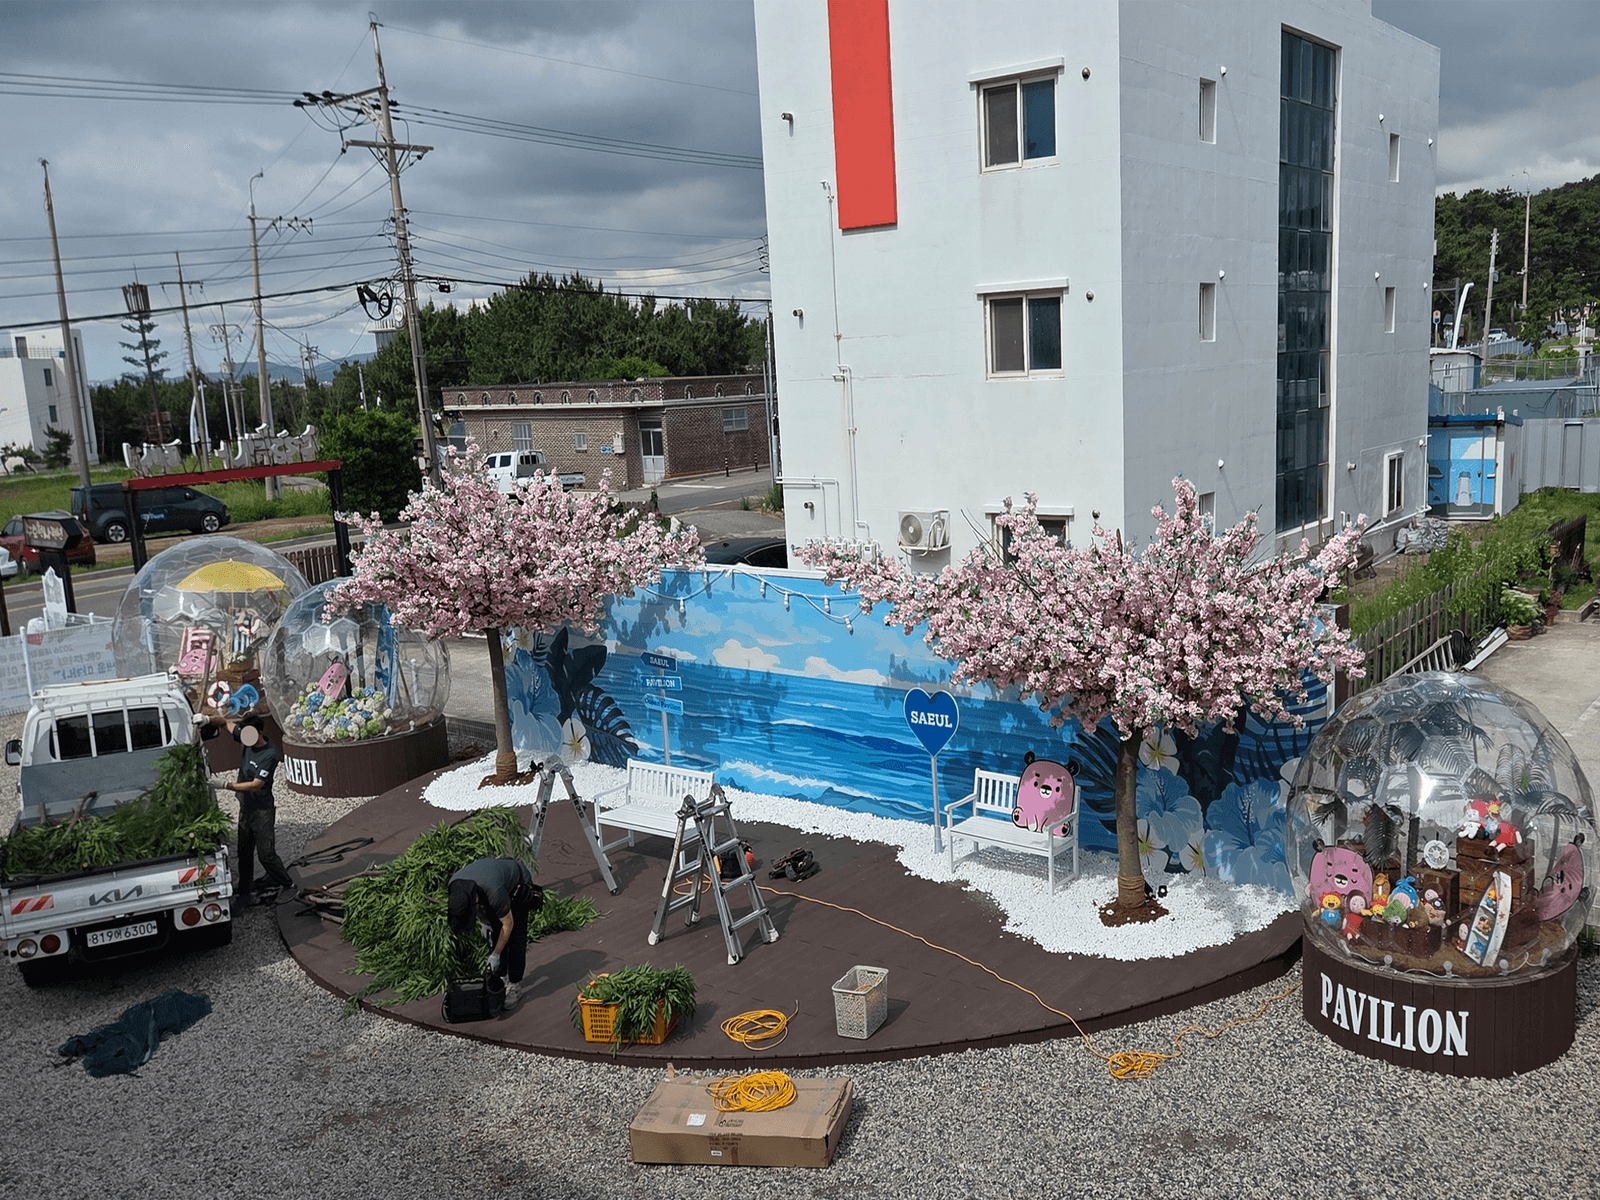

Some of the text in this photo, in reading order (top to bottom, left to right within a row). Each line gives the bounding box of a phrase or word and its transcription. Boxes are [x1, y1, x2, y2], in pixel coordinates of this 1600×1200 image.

[645, 678, 676, 688] PAVILION
[910, 710, 953, 728] SAEUL
[1320, 972, 1470, 1057] PAVILION
